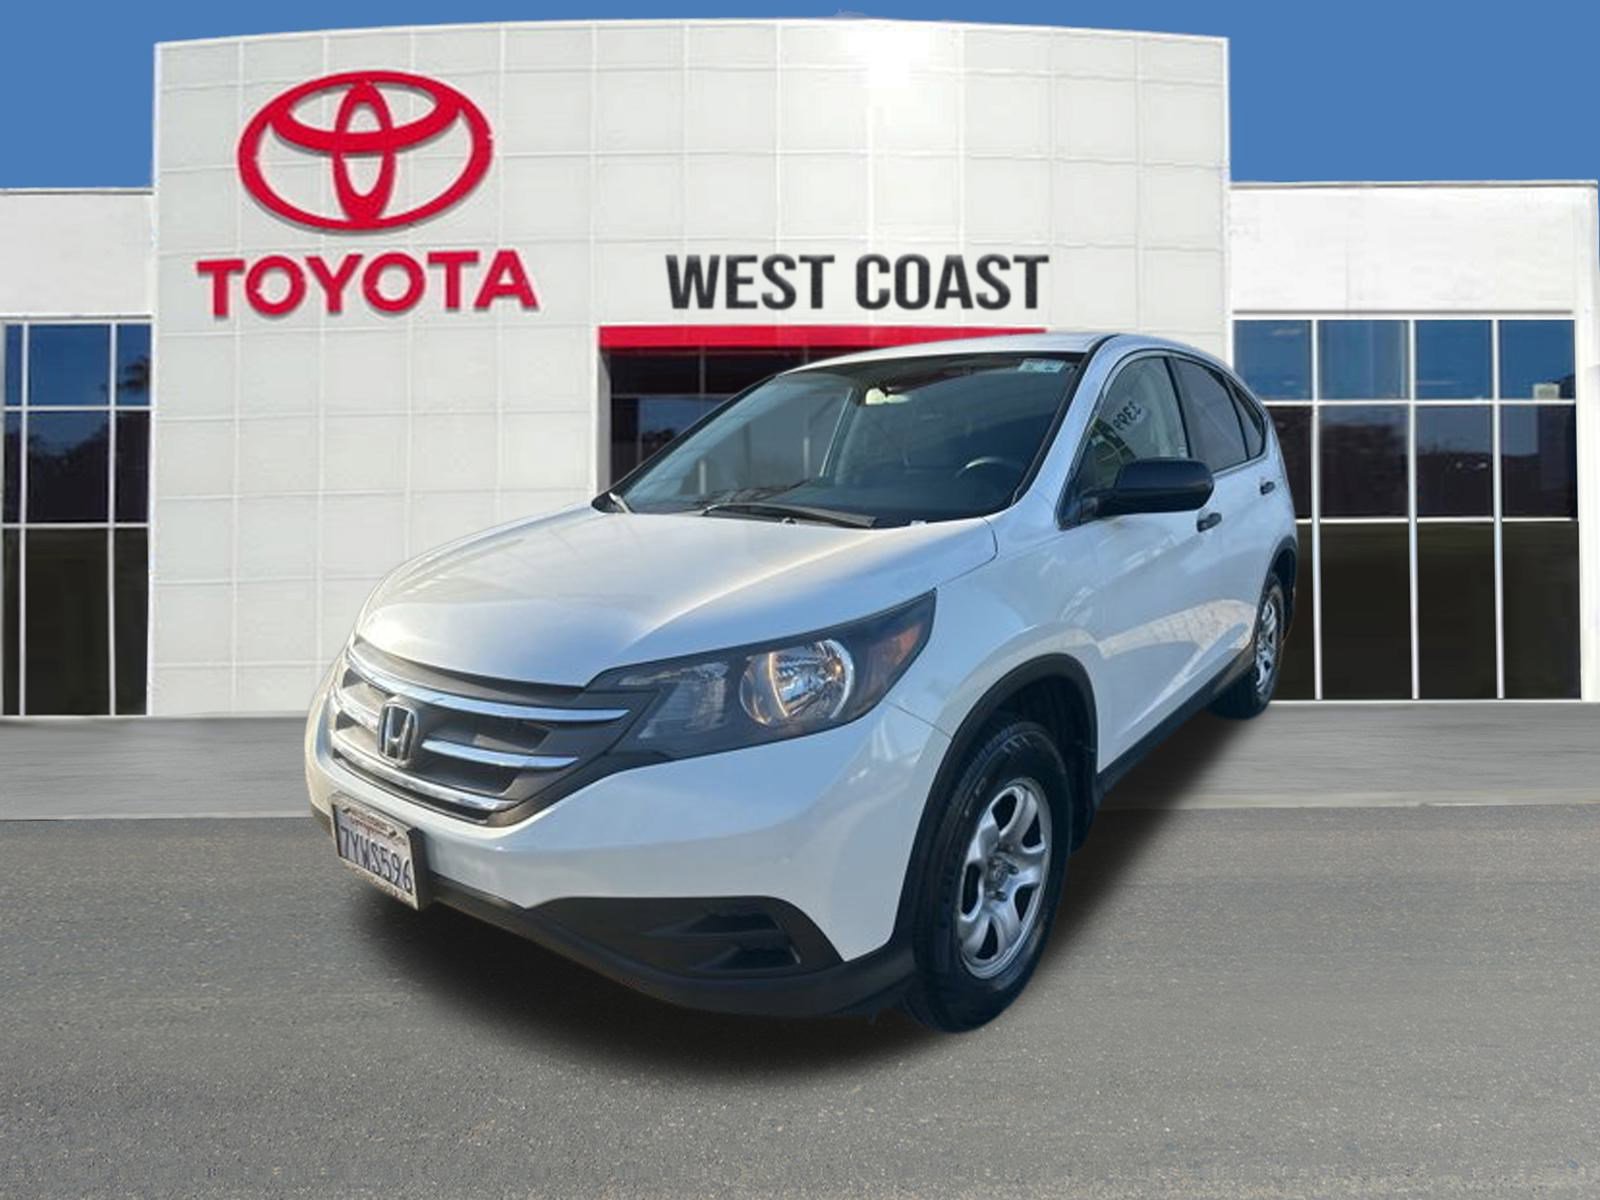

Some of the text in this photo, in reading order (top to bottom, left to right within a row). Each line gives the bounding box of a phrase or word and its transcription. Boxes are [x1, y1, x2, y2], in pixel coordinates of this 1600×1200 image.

[196, 250, 538, 318] TOYOTA
[665, 253, 1050, 310] WEST COAST
